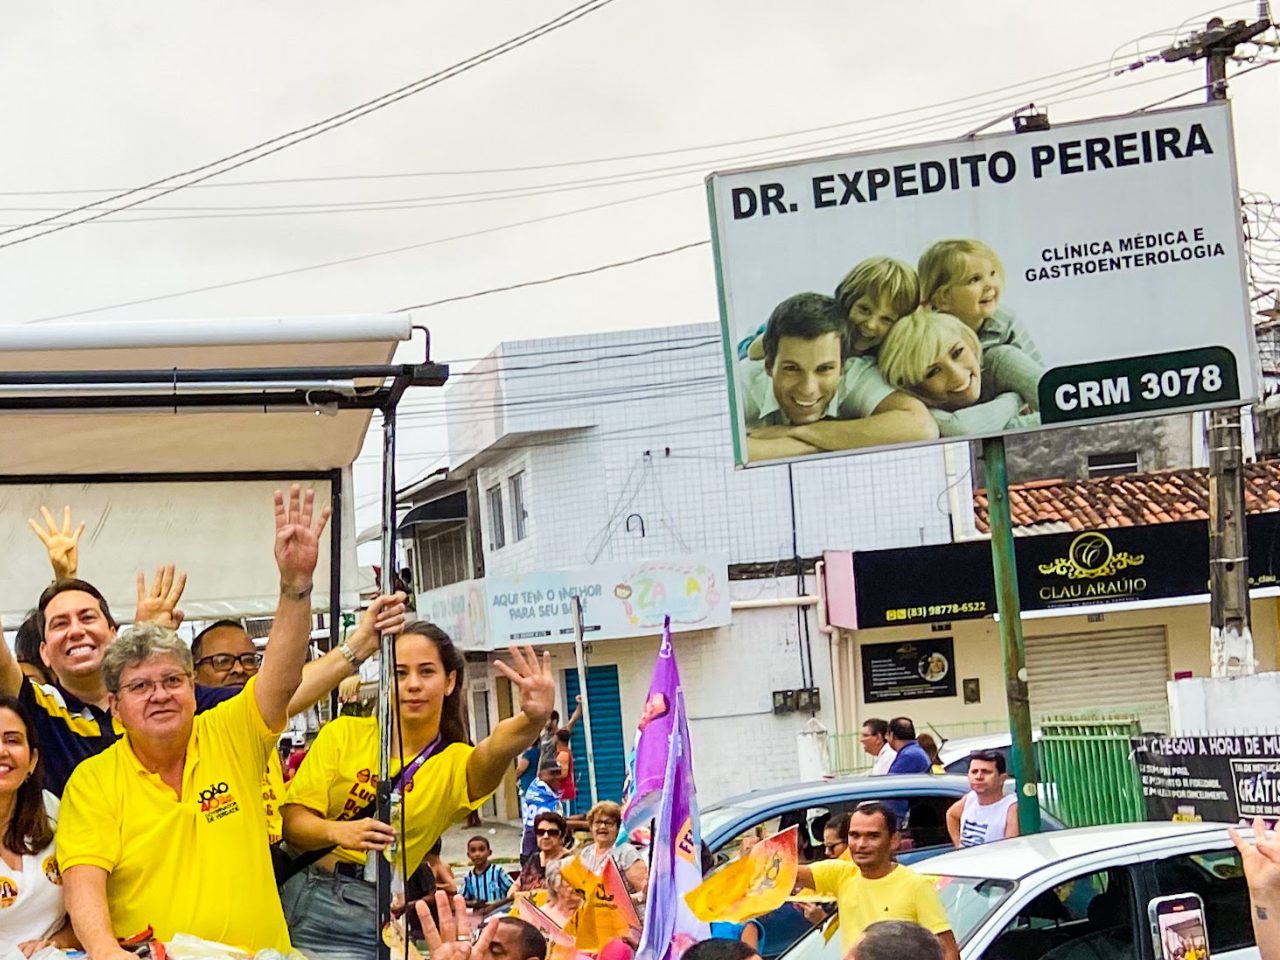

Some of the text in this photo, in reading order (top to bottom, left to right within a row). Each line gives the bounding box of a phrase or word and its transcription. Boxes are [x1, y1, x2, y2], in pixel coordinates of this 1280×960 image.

[731, 123, 1214, 220] DR. EXPEDITO PEREIRA
[1041, 228, 1204, 263] CLÍNICA MÉDICA E
[1025, 245, 1225, 283] GASTROENTEROLOGIA
[1054, 364, 1223, 412] CRM 3078
[492, 584, 602, 607] AQUI TEM O MELHOR
[1039, 577, 1147, 600] CLAU ARAÚJO
[509, 606, 536, 621] PARA
[538, 603, 559, 617] SEU
[907, 602, 986, 619] (83) 98778-6522
[1199, 738, 1207, 755] A
[1209, 738, 1241, 756] HORA
[1244, 737, 1260, 756] DE
